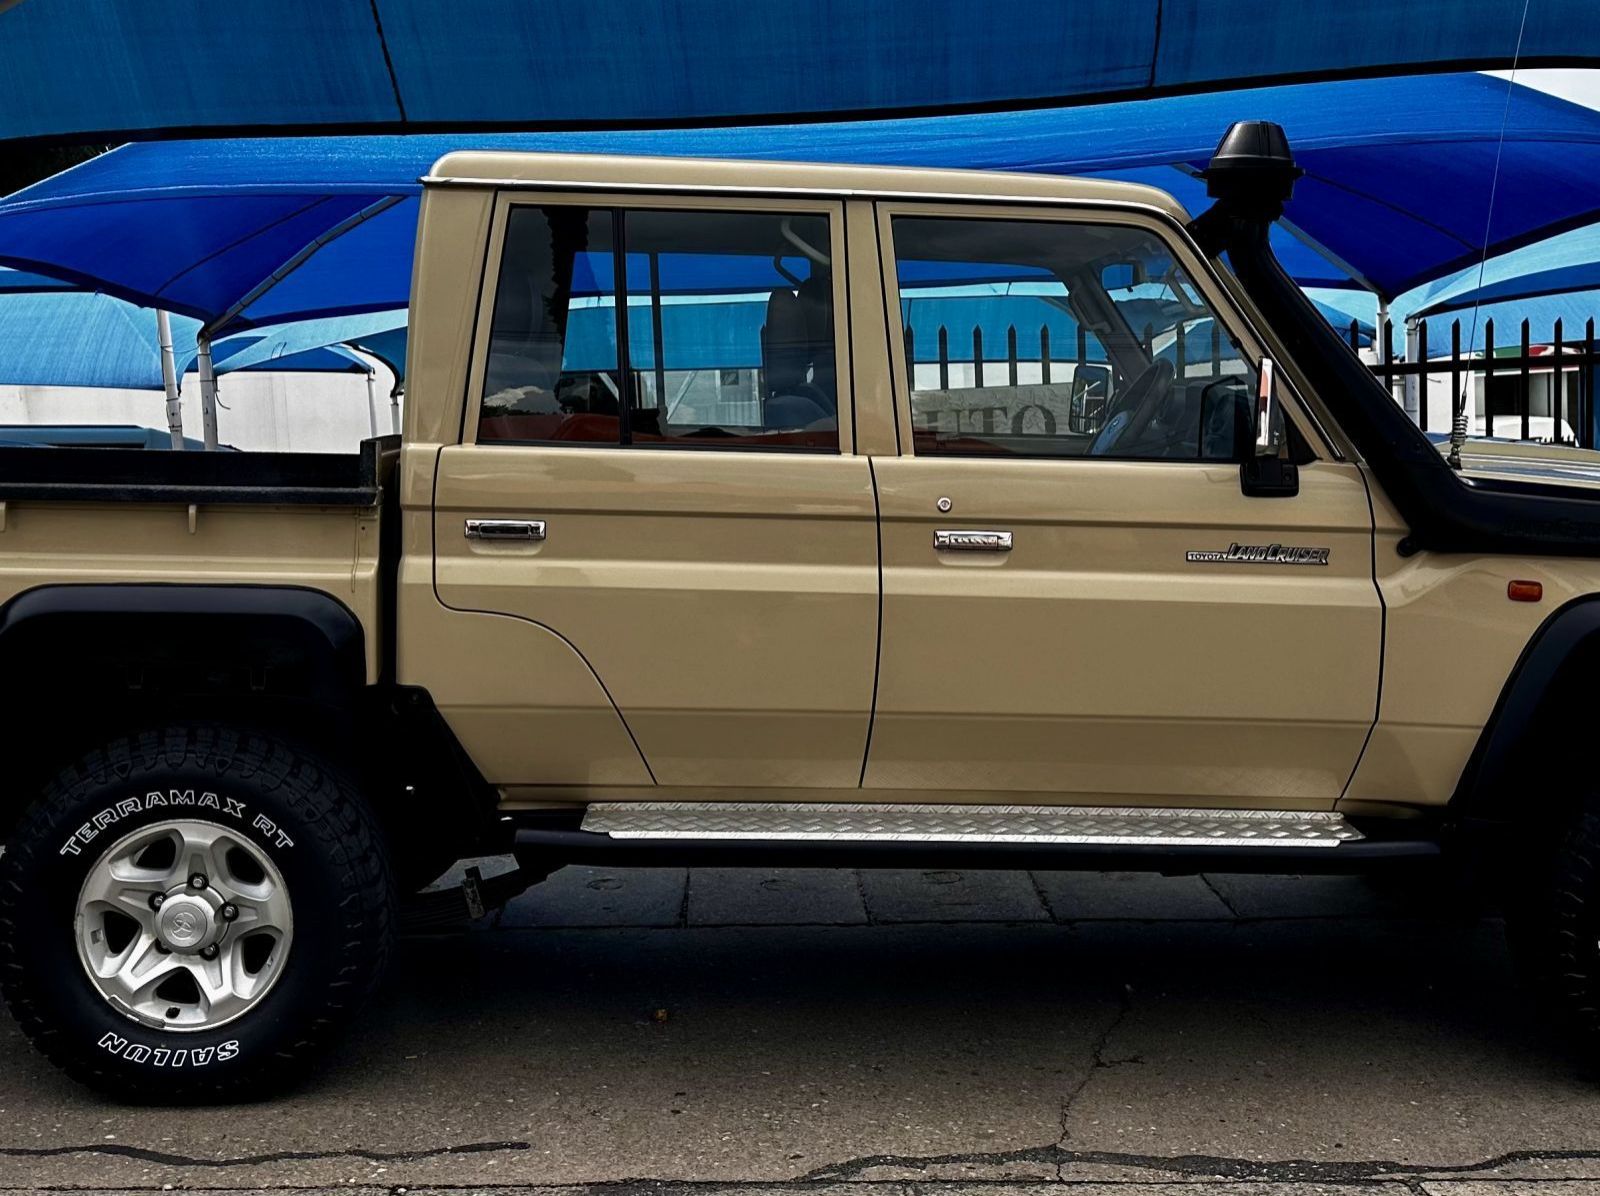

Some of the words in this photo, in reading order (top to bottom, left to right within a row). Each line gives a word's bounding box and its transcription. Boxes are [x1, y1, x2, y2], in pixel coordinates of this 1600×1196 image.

[1188, 551, 1226, 560] TOYOTA
[60, 789, 246, 857] TERRAMAX
[252, 813, 294, 850] RT
[98, 1031, 239, 1067] SAILUN
